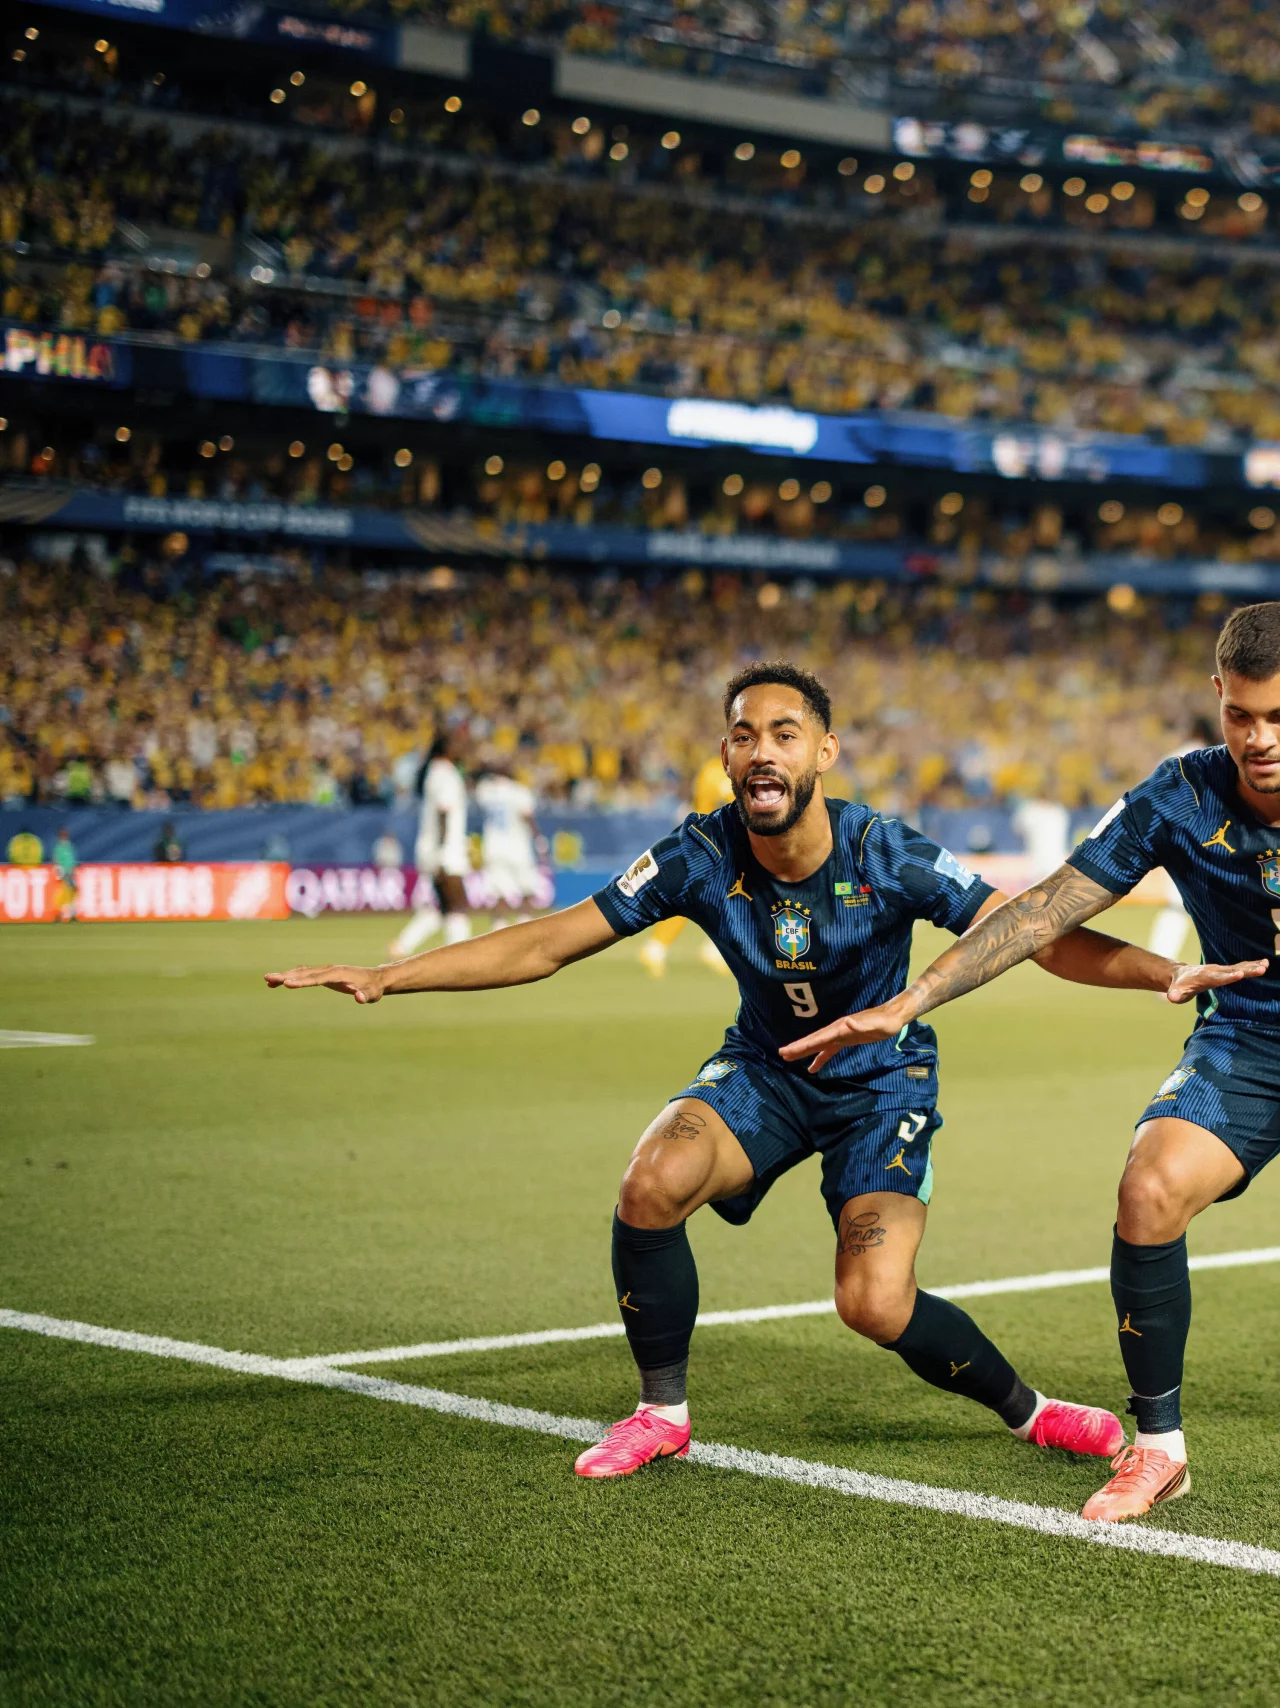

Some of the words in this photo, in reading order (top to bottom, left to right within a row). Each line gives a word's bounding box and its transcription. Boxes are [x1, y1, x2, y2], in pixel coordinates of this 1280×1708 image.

[285, 868, 405, 918] QATAR
[785, 927, 799, 935] CBF
[775, 959, 817, 971] BRASIL
[783, 982, 819, 1018] 9
